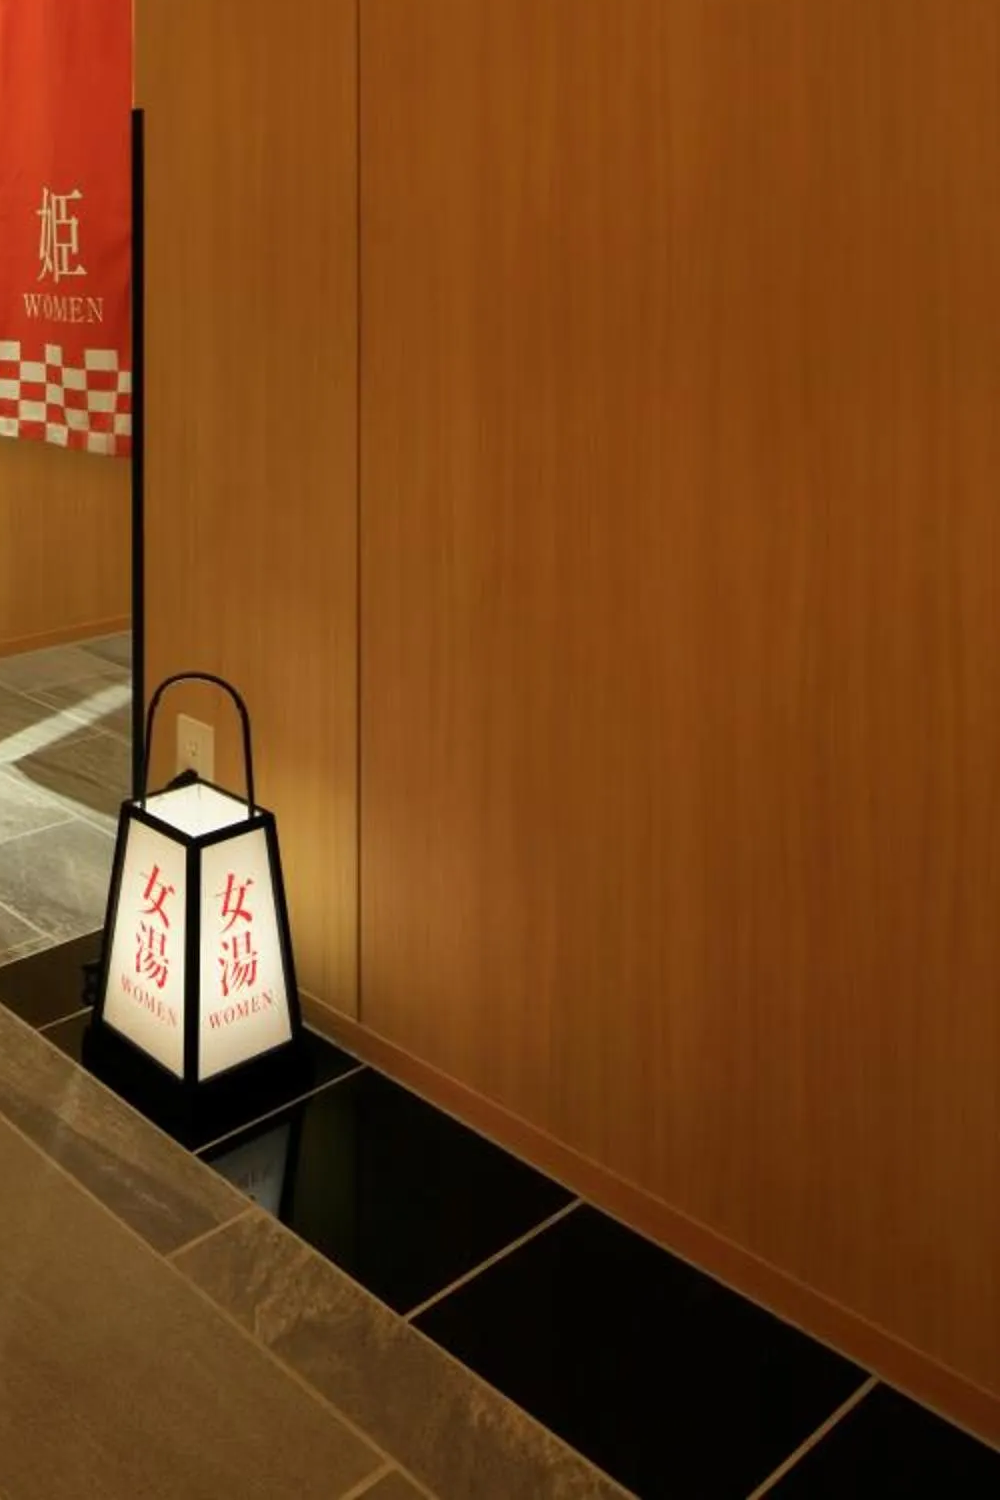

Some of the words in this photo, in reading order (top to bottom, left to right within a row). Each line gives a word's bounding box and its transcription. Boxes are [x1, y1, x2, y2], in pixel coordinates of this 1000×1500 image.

[36, 187, 87, 283] 姫
[23, 293, 104, 323] WOMEN
[135, 864, 175, 989] 女湯
[215, 873, 258, 997] 女湯
[120, 974, 178, 1027] WOMEN
[209, 989, 275, 1029] WOMEN
